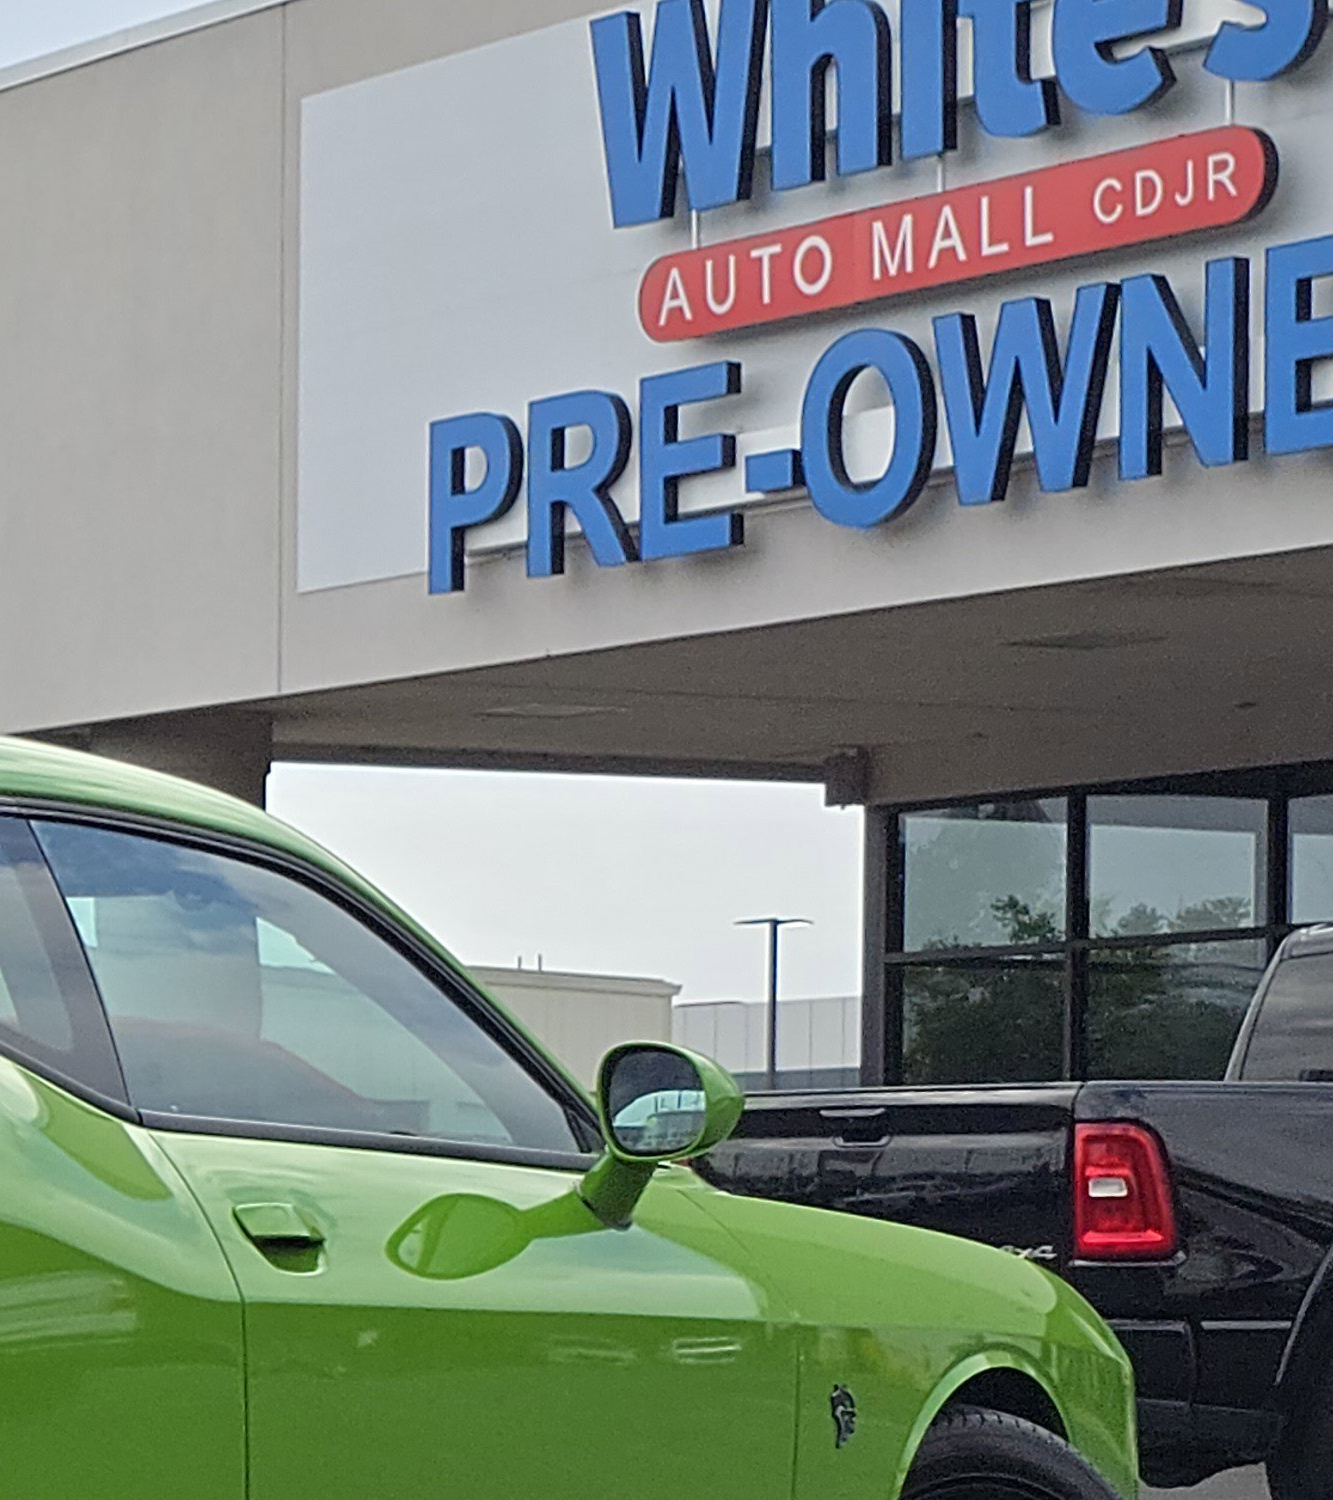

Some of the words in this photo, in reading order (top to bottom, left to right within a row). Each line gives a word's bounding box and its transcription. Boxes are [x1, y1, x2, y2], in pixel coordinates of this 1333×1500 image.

[590, 0, 1329, 229] Whites
[657, 235, 834, 327] AUTO
[870, 185, 1054, 283] MALL
[1092, 151, 1240, 225] CDJR
